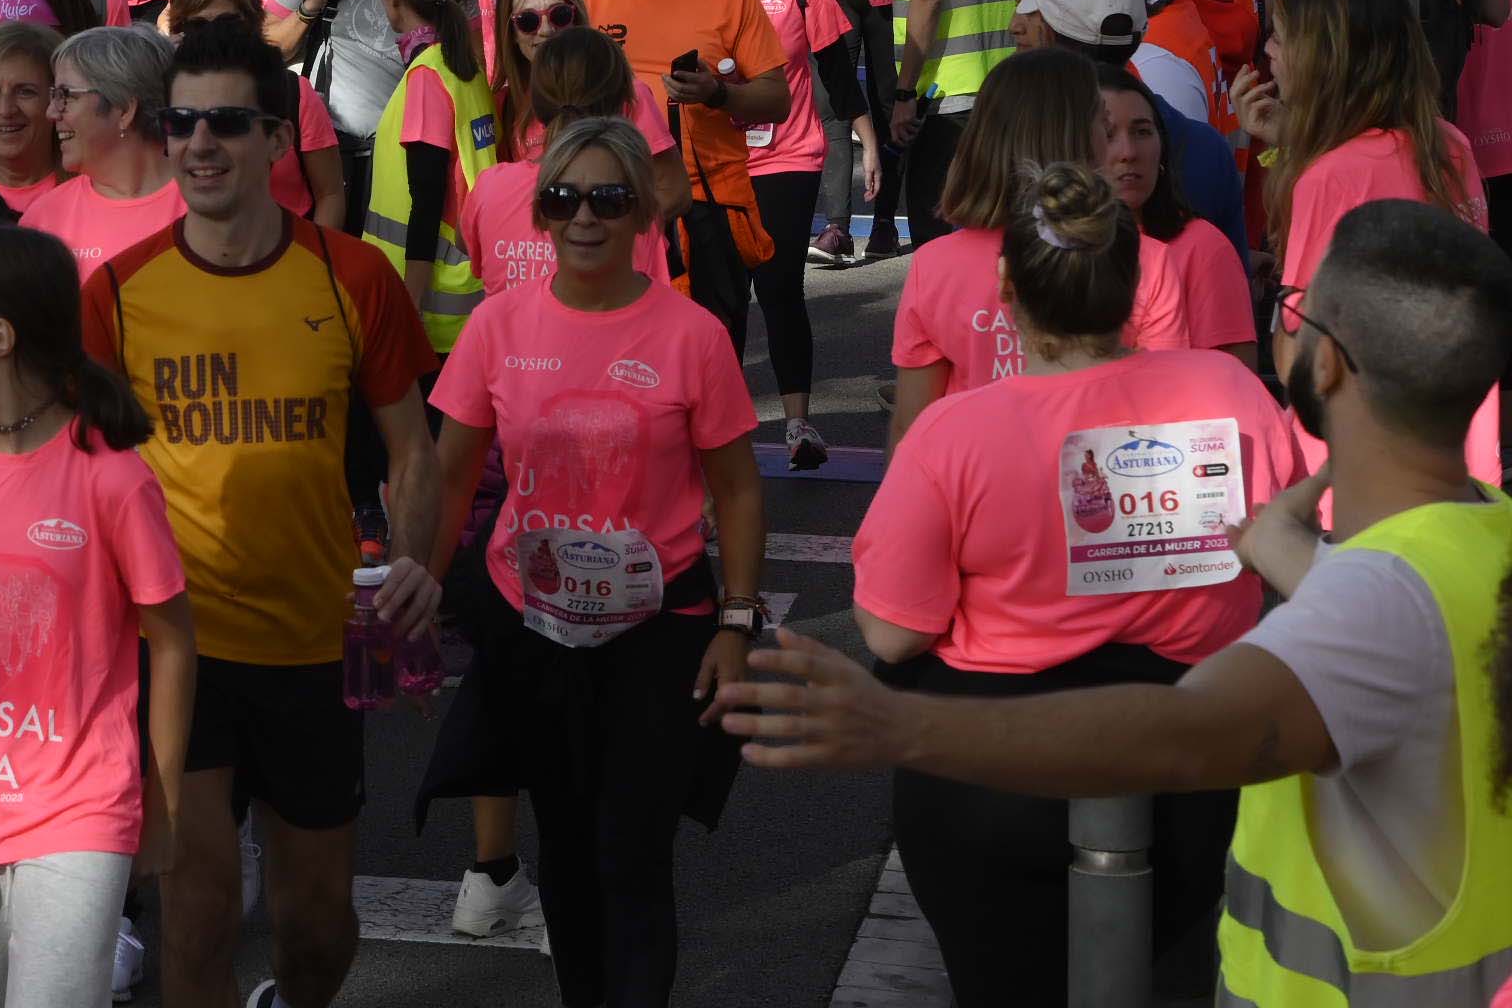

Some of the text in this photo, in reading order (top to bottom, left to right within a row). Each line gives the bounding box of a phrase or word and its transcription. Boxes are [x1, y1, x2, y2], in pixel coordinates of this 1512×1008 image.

[0, 2, 39, 21] Mujer
[69, 246, 102, 259] SHO
[506, 260, 550, 281] DE LA
[504, 355, 563, 371] OYSHO
[153, 352, 238, 401] RUN
[159, 396, 328, 447] BOUINER
[1111, 441, 1226, 471] ASTURIANA SUMA
[1118, 489, 1181, 516] 016
[30, 528, 85, 545] ASTURIANA
[1127, 520, 1175, 538] 27213
[560, 548, 616, 566] ASTURIANA
[1087, 537, 1229, 558] CARRERA DE LA MUJER 2023
[1083, 561, 1235, 584] OYSHO Santander
[563, 576, 613, 597] 016
[567, 598, 607, 613] 27272
